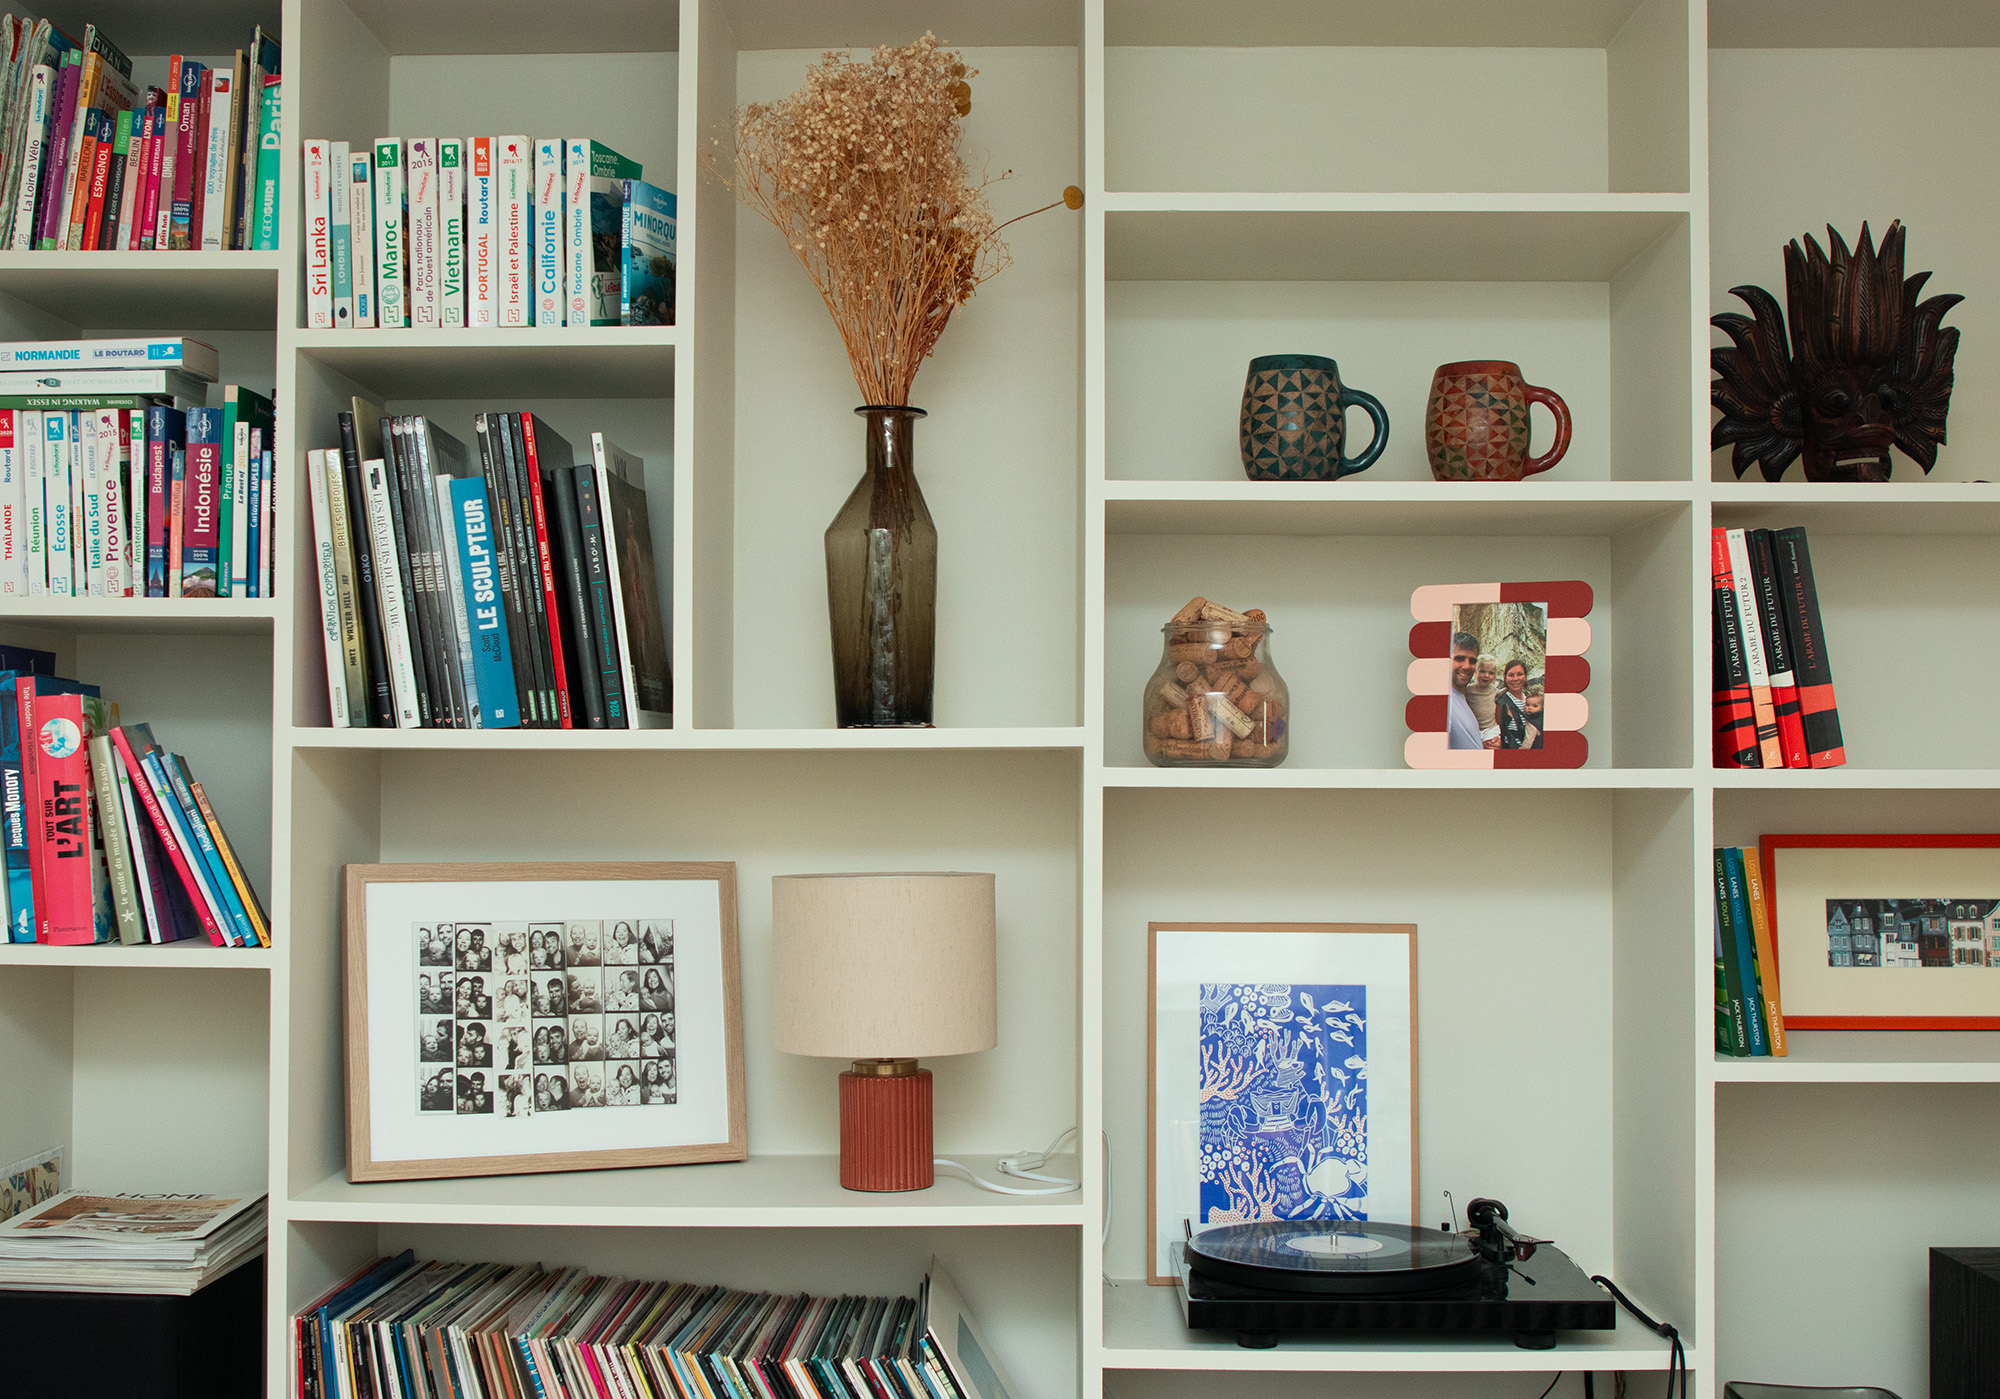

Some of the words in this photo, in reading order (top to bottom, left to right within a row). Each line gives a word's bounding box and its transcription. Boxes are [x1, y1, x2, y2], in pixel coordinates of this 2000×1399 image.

[144, 119, 153, 139] LYON
[179, 103, 191, 132] Oman
[261, 86, 281, 150] Paris
[116, 118, 130, 147] Italien
[186, 129, 194, 148] Émirats
[210, 127, 218, 142] rêve
[29, 140, 40, 161] Vélo
[79, 139, 93, 182] BARCELONE
[130, 139, 141, 167] BERLIN
[139, 140, 150, 175] Cartoville
[152, 138, 162, 176] AMSTERDAM
[209, 143, 217, 151] de
[93, 148, 108, 198] ESPAGNOL
[114, 156, 124, 191] CONVERSATION
[162, 156, 174, 178] OMAN
[208, 153, 217, 180] voyages
[412, 157, 433, 169] 2015
[593, 164, 615, 178] Ombrie
[27, 172, 36, 198] Loire
[207, 181, 215, 194] 200
[23, 200, 33, 212] La
[110, 200, 119, 214] GUIDE
[478, 178, 489, 224] Routard
[424, 207, 432, 252] américain
[508, 203, 518, 255] Palestine
[573, 208, 583, 246] Ombrie
[622, 207, 631, 249] MINORQUE
[634, 211, 676, 241] MINORQU
[311, 217, 326, 267] Lanka
[383, 220, 398, 279] Maroc
[415, 218, 423, 263] nationaux
[541, 210, 556, 293] Californie
[338, 239, 346, 284] LONDRES
[445, 218, 460, 296] Vietnam
[478, 233, 488, 300] PORTUGAL
[511, 258, 518, 269] et
[312, 274, 327, 295] Sri
[416, 267, 424, 291] Parcs
[425, 255, 433, 288] l'Ouest
[573, 250, 583, 295] Toscane,
[426, 291, 433, 302] de
[509, 273, 518, 303] Israël
[15, 350, 80, 361] NORMANDIE
[100, 429, 117, 439] 2015
[152, 445, 164, 493] Budapest
[251, 462, 259, 491] NAPLES
[172, 483, 181, 516] MADRID
[193, 448, 212, 533] Indonésie
[238, 495, 244, 504] Le
[331, 473, 342, 513] PERDUES
[372, 493, 384, 513] LES
[88, 494, 99, 517] Sud
[250, 493, 259, 527] Cartoville
[3, 504, 13, 560] THAÏLANDE
[30, 507, 41, 552] Réunion
[52, 504, 66, 551] Écosse
[75, 506, 83, 548] Copenhague
[89, 520, 100, 536] du
[105, 480, 119, 561] Provence
[335, 515, 346, 547] BALLES
[133, 512, 142, 563] Amsterdam
[376, 515, 391, 564] RÊVEURS
[463, 499, 495, 603] SCULPTEUR
[540, 541, 549, 561] TSAR
[90, 539, 101, 569] Italie
[322, 542, 335, 597] COPPERHEAD
[361, 554, 371, 582] OKKO
[382, 567, 393, 586] DU
[542, 564, 549, 572] AU
[544, 575, 552, 591] MORT
[1764, 577, 1775, 610] FUTUR
[343, 591, 352, 609] HILL
[385, 587, 400, 629] LOUVRE
[1721, 585, 1733, 617] FUTUR
[1741, 583, 1752, 616] FUTUR
[1795, 582, 1806, 613] FUTUR
[325, 600, 339, 641] OPÉRATION
[344, 611, 355, 642] WALTER
[476, 606, 498, 630] LE
[1726, 621, 1735, 634] DU
[1746, 620, 1755, 633] DU
[1769, 613, 1778, 627] DU
[1801, 616, 1809, 629] DU
[481, 634, 491, 652] Scott
[491, 633, 502, 662] McCloud
[349, 648, 357, 666] MATZ
[22, 686, 31, 699] Tate
[421, 692, 429, 719] DARGAUD
[24, 701, 33, 727] Modern
[609, 700, 620, 717] 2024
[26, 728, 34, 740] The
[27, 742, 36, 775] Handbook
[5, 769, 20, 812] Monory
[99, 763, 110, 791] Branly
[133, 771, 151, 794] VISITE
[45, 800, 53, 818] SUR
[104, 793, 115, 812] quai
[145, 792, 157, 803] DE
[54, 780, 84, 859] L'ART
[108, 814, 116, 826] du
[151, 803, 165, 826] GUIDE
[10, 812, 23, 847] Jacques
[46, 819, 55, 842] TOUT
[110, 828, 121, 856] musée
[160, 828, 177, 851] ORSAY
[189, 808, 213, 851] Modigliani
[115, 858, 123, 869] du
[1716, 859, 1724, 875] LOST
[1727, 858, 1736, 875] LOST
[1749, 859, 1757, 877] LOST
[118, 871, 128, 895] guide
[1718, 878, 1727, 899] LANES
[1731, 876, 1739, 898] LANES
[1752, 878, 1760, 900] LANES
[120, 896, 129, 905] le
[1721, 901, 1730, 926] SOUTH
[1734, 900, 1742, 924] WALES
[1755, 903, 1763, 929] NORTH
[1733, 999, 1741, 1014] JACK
[1747, 997, 1756, 1012] JACK
[1768, 1001, 1777, 1015] JACK
[1736, 1014, 1745, 1047] THURSTON
[1751, 1012, 1760, 1045] THURSTON
[1772, 1015, 1782, 1049] THURSTON
